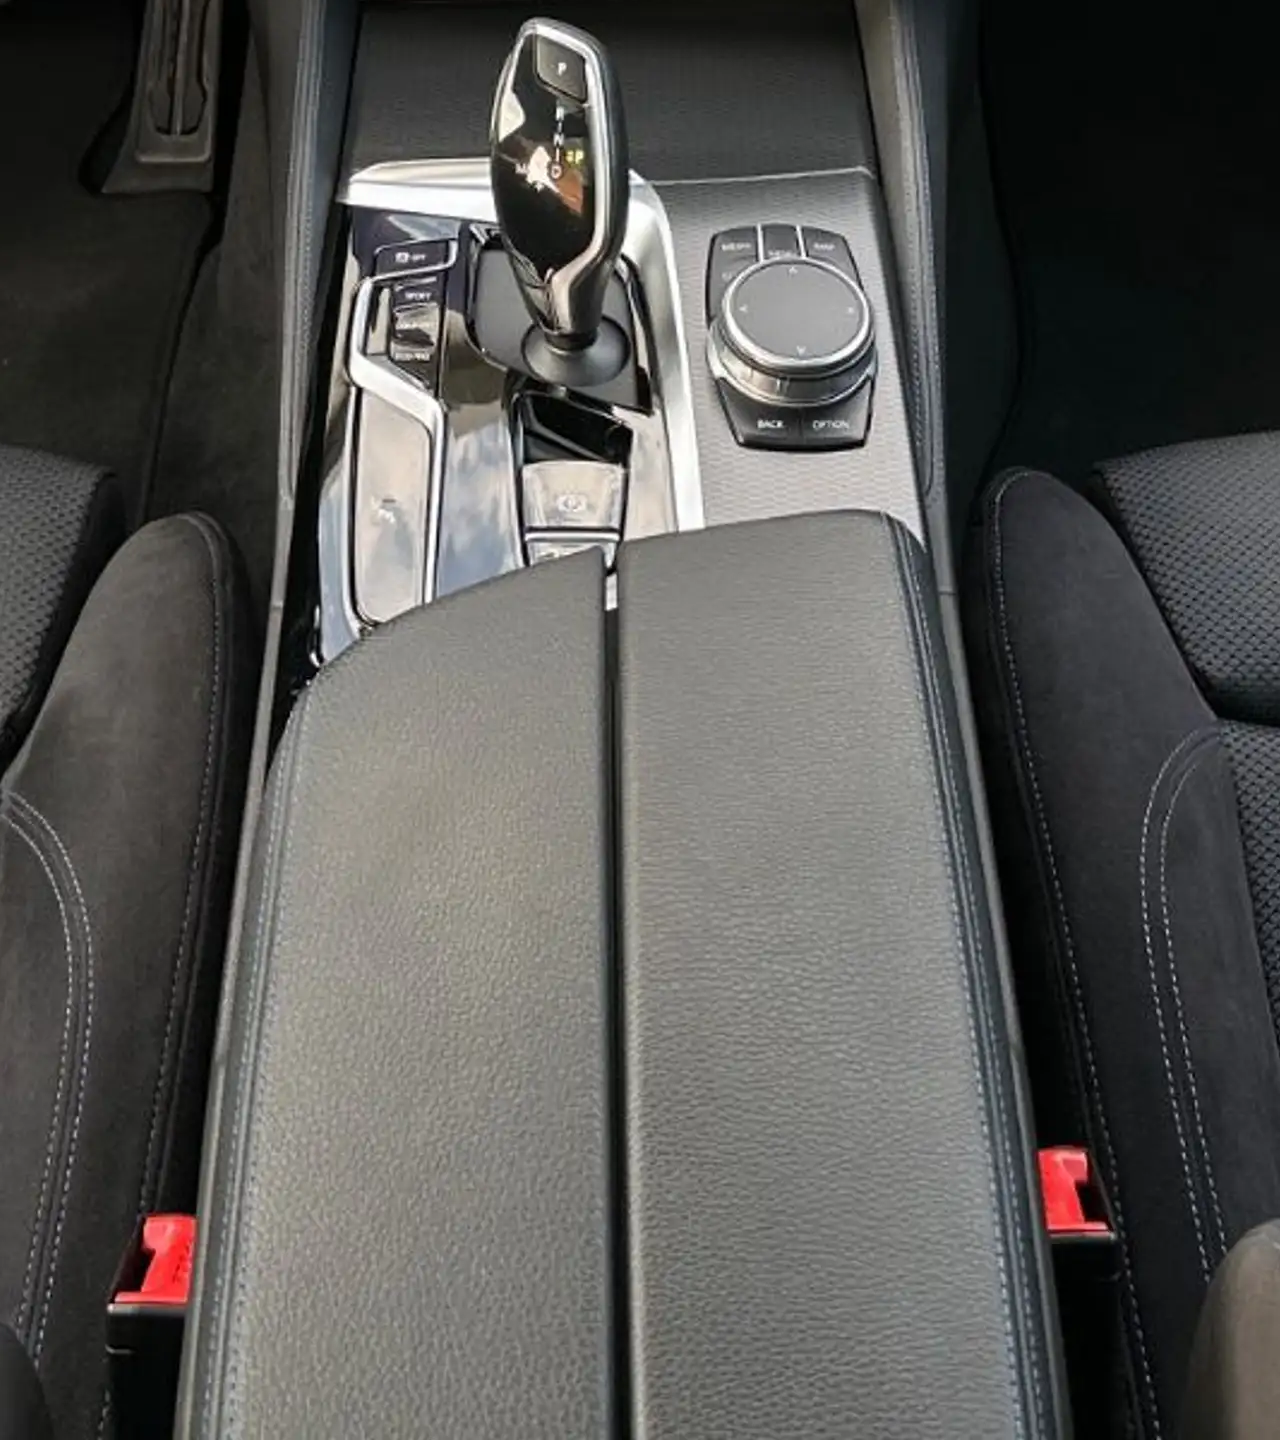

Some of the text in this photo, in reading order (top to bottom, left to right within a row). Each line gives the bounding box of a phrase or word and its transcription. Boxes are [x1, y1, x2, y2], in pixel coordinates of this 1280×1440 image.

[557, 61, 568, 75] P
[554, 133, 565, 147] N
[757, 419, 784, 430] BACK
[812, 418, 850, 430] OPTION
